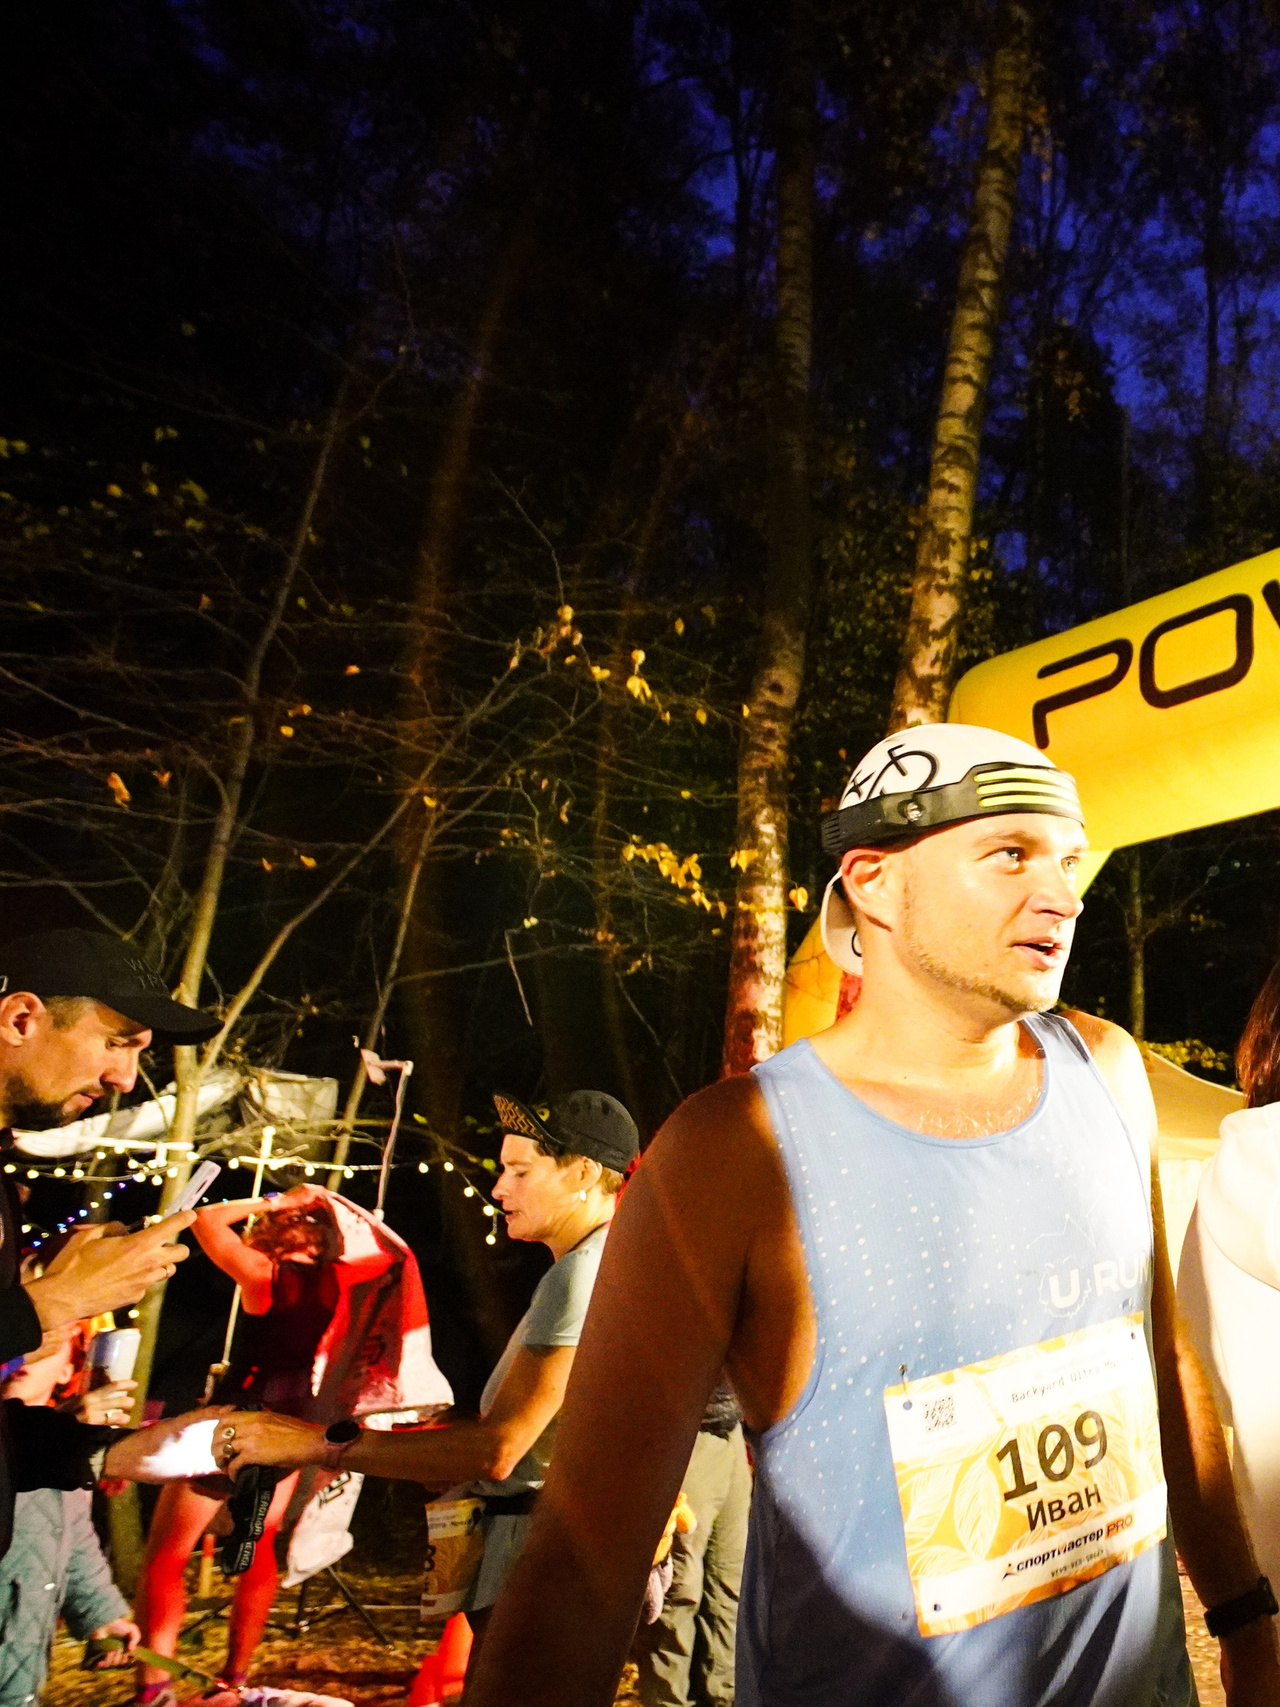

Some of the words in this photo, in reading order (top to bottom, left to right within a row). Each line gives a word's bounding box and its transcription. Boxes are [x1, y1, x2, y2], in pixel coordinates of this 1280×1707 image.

[1010, 1376, 1066, 1403] Backyard
[1069, 1364, 1101, 1382] Ultra
[995, 1410, 1108, 1503] 109
[1026, 1482, 1102, 1533] Иван
[1106, 1512, 1134, 1538] PRO
